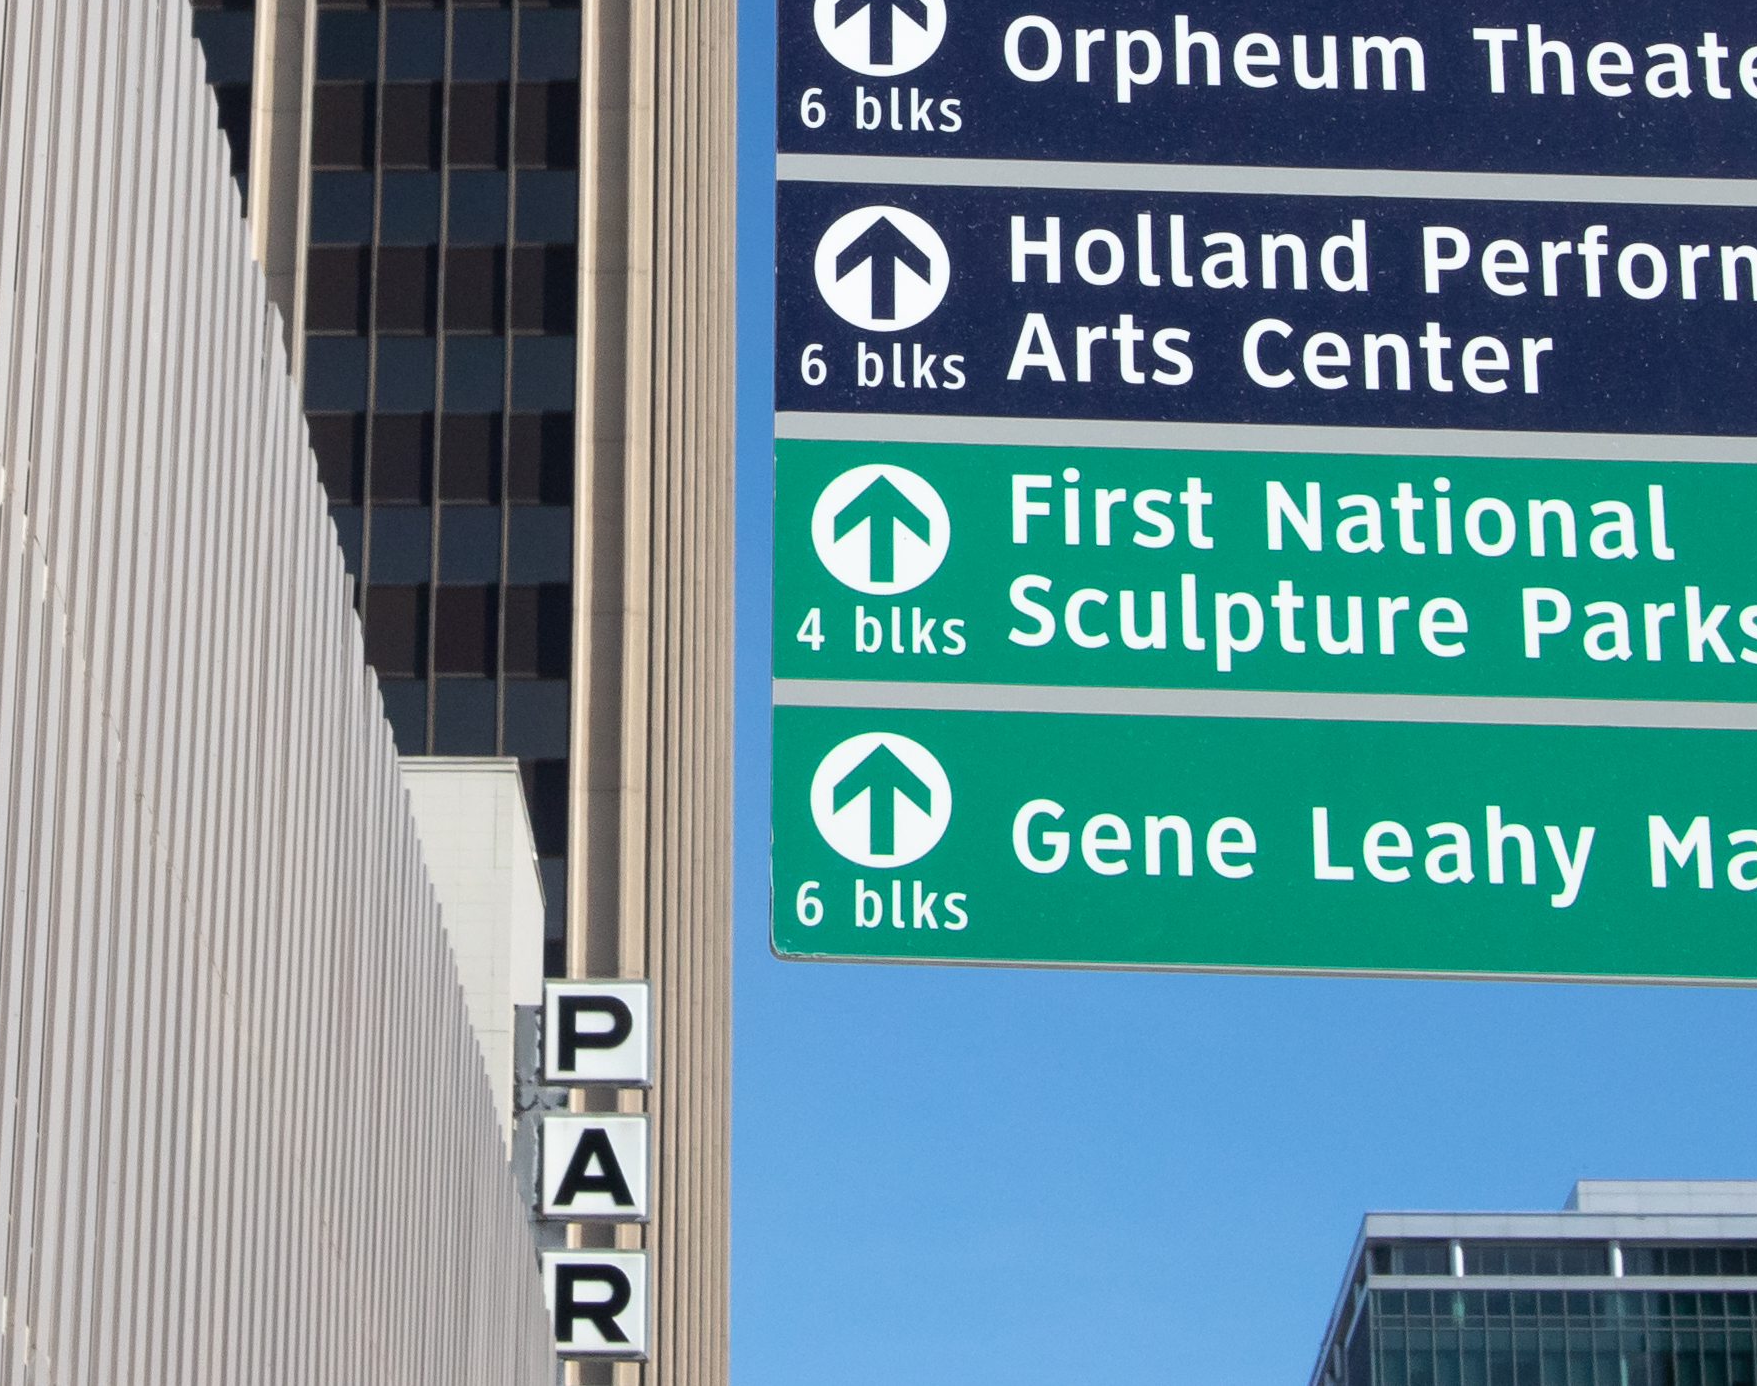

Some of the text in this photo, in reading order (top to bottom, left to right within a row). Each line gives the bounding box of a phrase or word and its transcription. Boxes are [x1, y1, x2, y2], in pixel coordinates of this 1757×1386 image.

[1003, 14, 1426, 104] Orpheum
[800, 85, 962, 133] 6 blks
[1010, 213, 1369, 292] Holland
[800, 341, 966, 390] 6 blks
[1006, 312, 1554, 394] Arts Center
[1011, 467, 1675, 561] First National
[796, 605, 967, 656] 4 blks
[1008, 573, 1469, 672] Sculpture
[1012, 798, 1257, 879] Gene
[1312, 805, 1596, 909] Leahy
[796, 878, 969, 931] 6 blks
